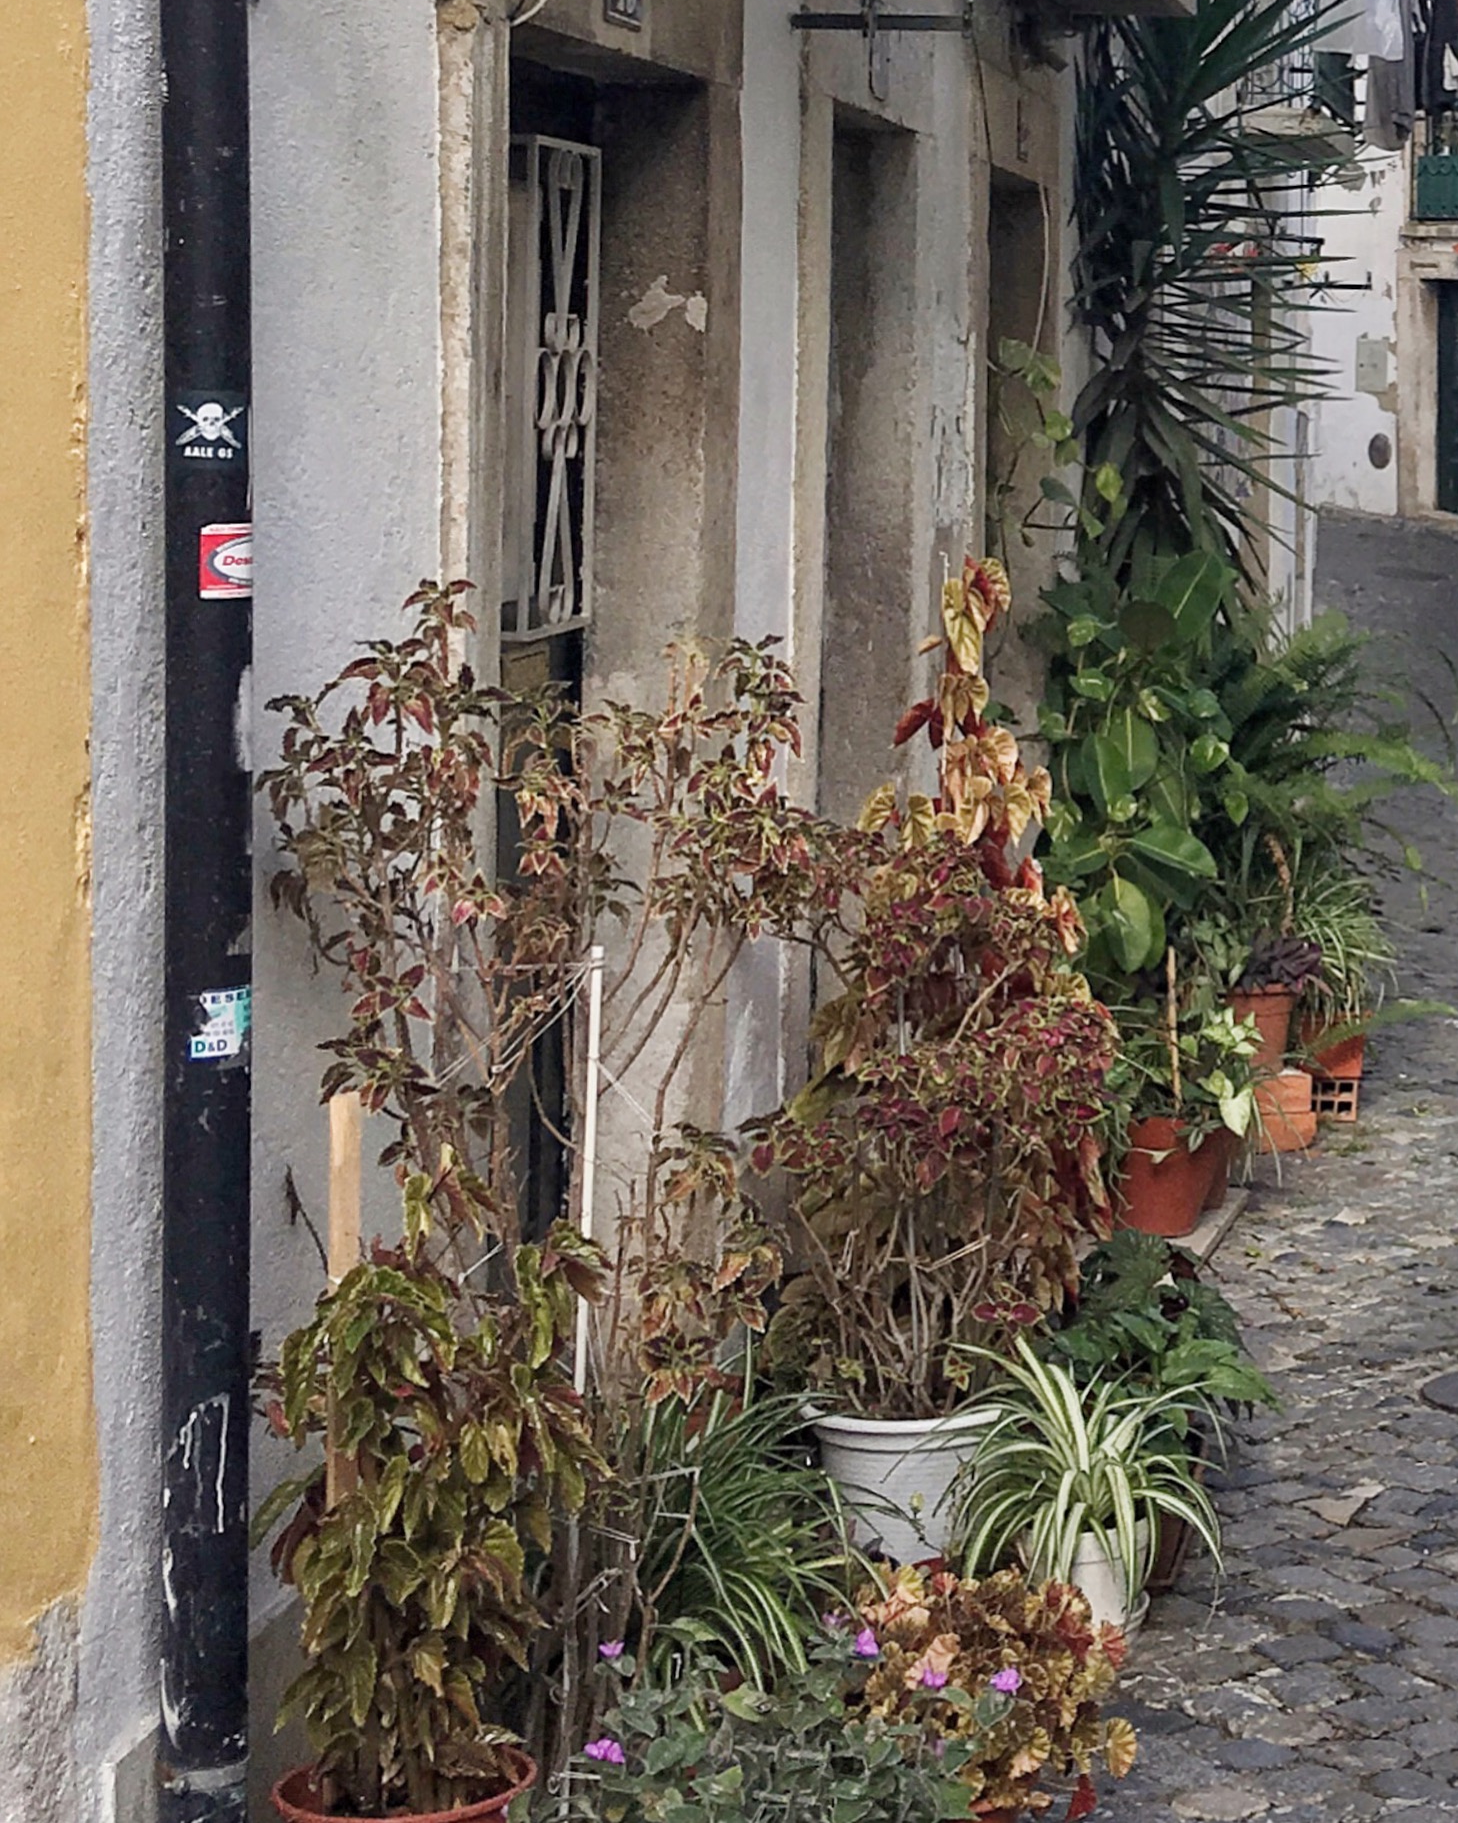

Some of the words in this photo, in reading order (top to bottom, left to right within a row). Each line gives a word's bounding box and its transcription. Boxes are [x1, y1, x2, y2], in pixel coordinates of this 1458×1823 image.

[184, 444, 214, 459] AALE
[217, 446, 234, 459] GS
[194, 1038, 227, 1054] D&D
